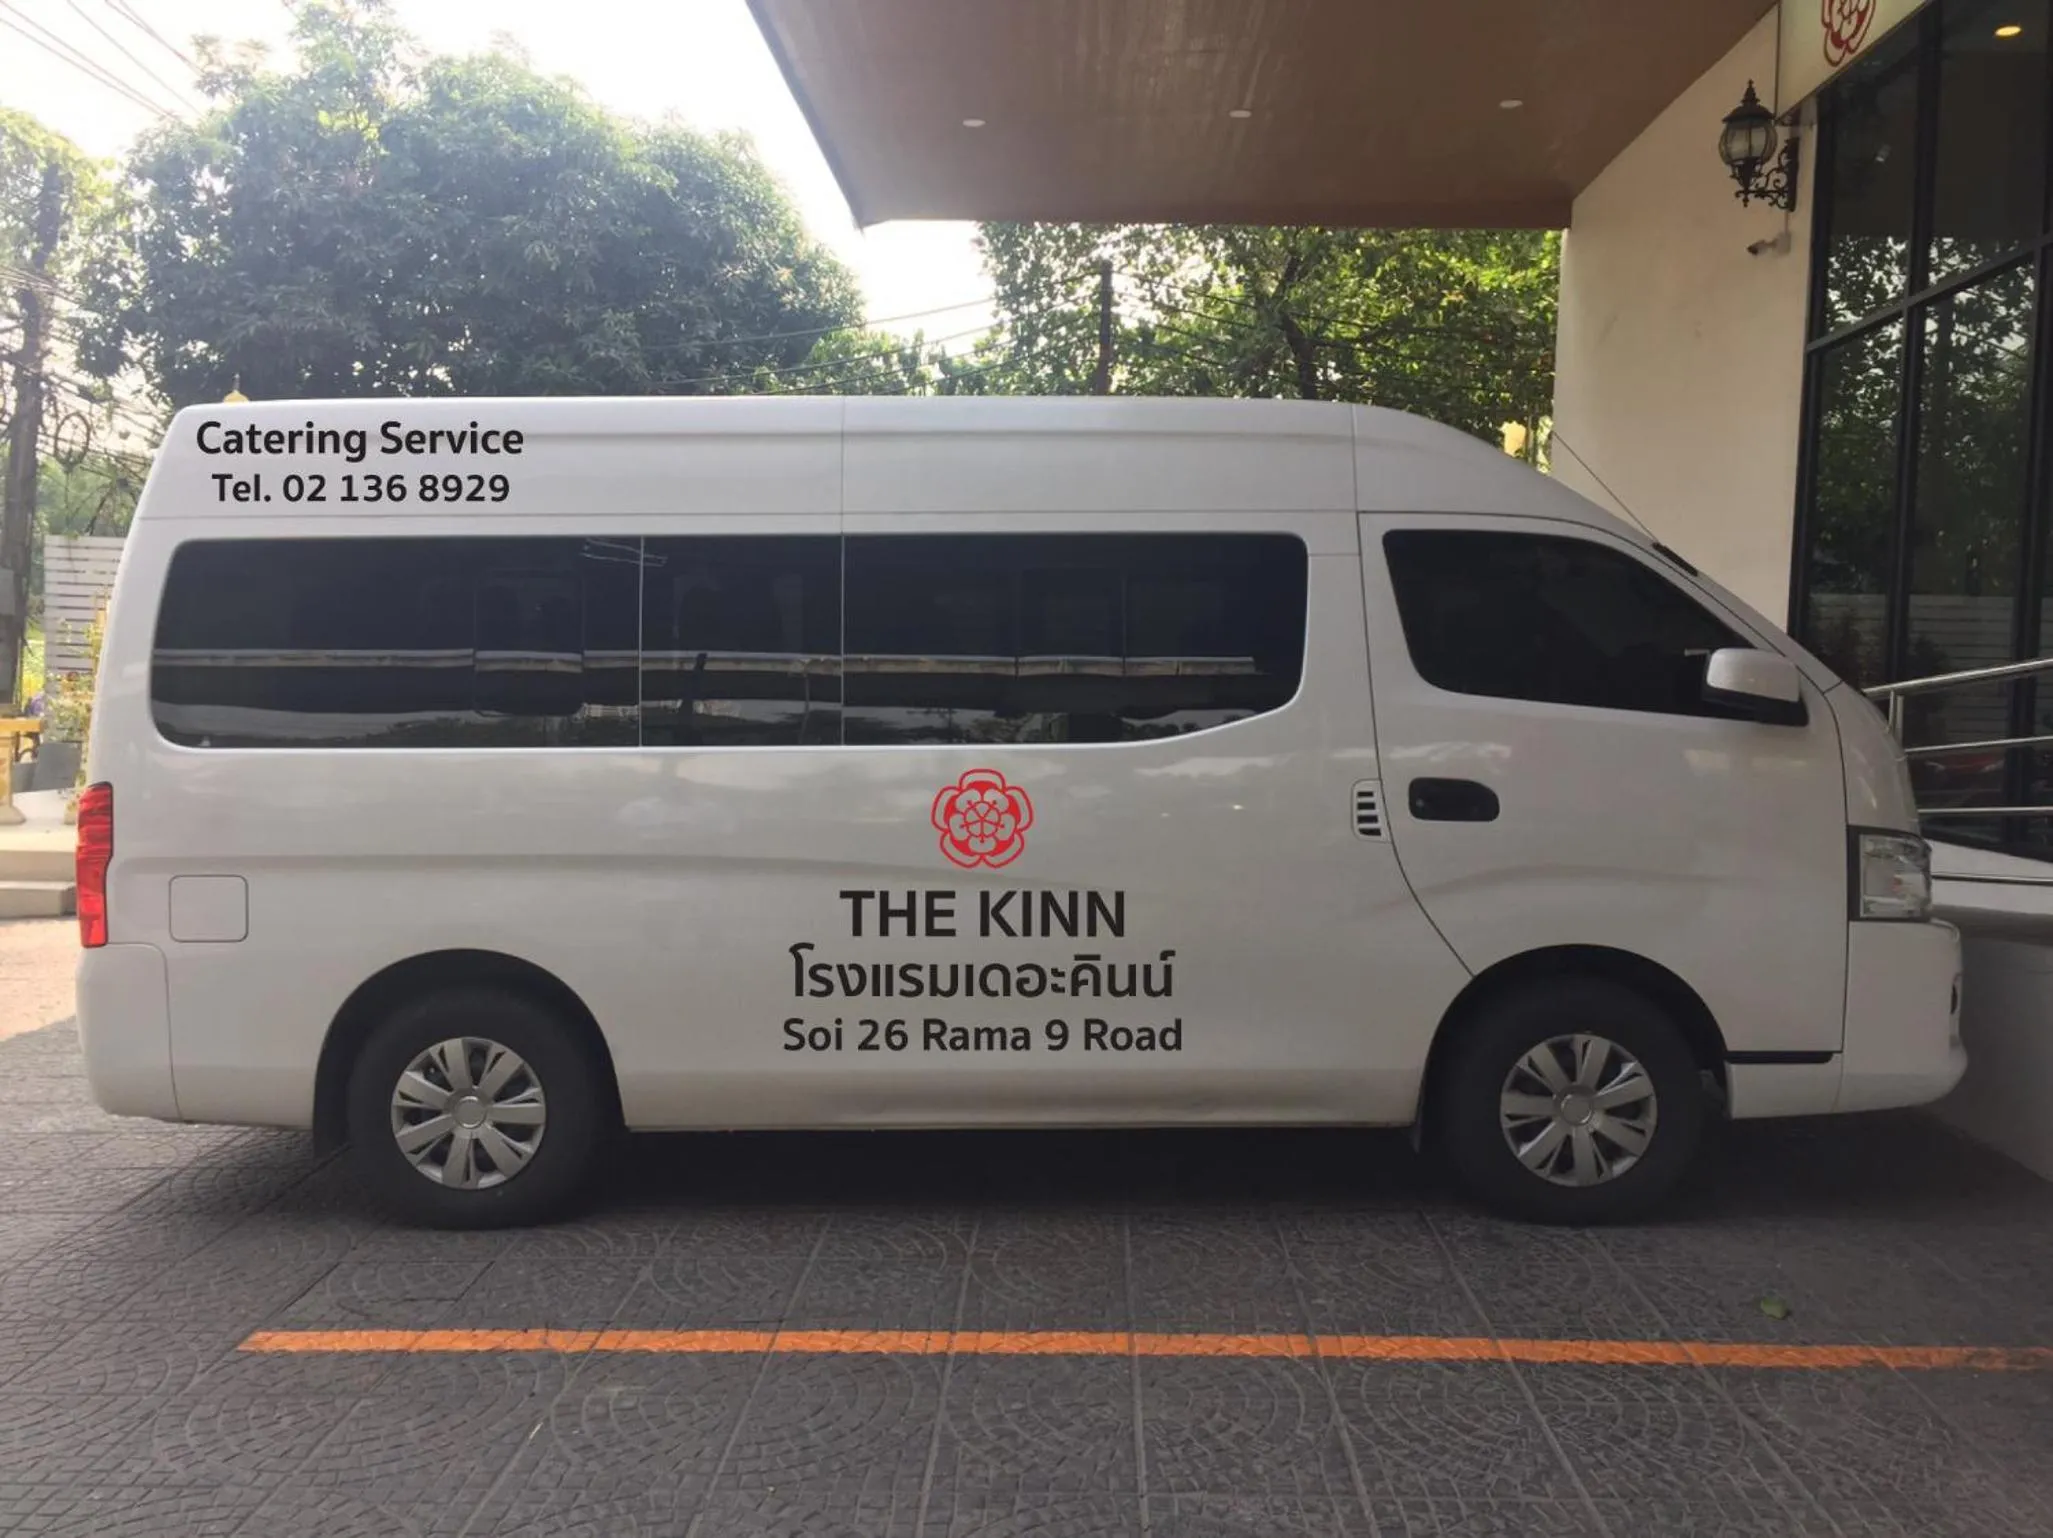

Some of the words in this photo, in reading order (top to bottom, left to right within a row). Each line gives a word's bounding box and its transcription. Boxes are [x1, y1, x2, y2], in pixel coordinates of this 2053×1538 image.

[196, 420, 367, 463] Catering
[380, 420, 524, 455] Service
[211, 473, 272, 503] Tel.
[282, 474, 327, 503] 02
[340, 474, 407, 503] 136
[418, 474, 510, 503] 8929
[839, 889, 957, 938] THE
[979, 889, 1126, 938] KINN
[788, 941, 1177, 999] โรงแรมเดอะคินน์
[783, 1017, 844, 1052] Soi
[857, 1018, 909, 1052] 26
[922, 1017, 1032, 1052] Rama
[1044, 1018, 1070, 1052] 9
[1083, 1017, 1183, 1052] Road
